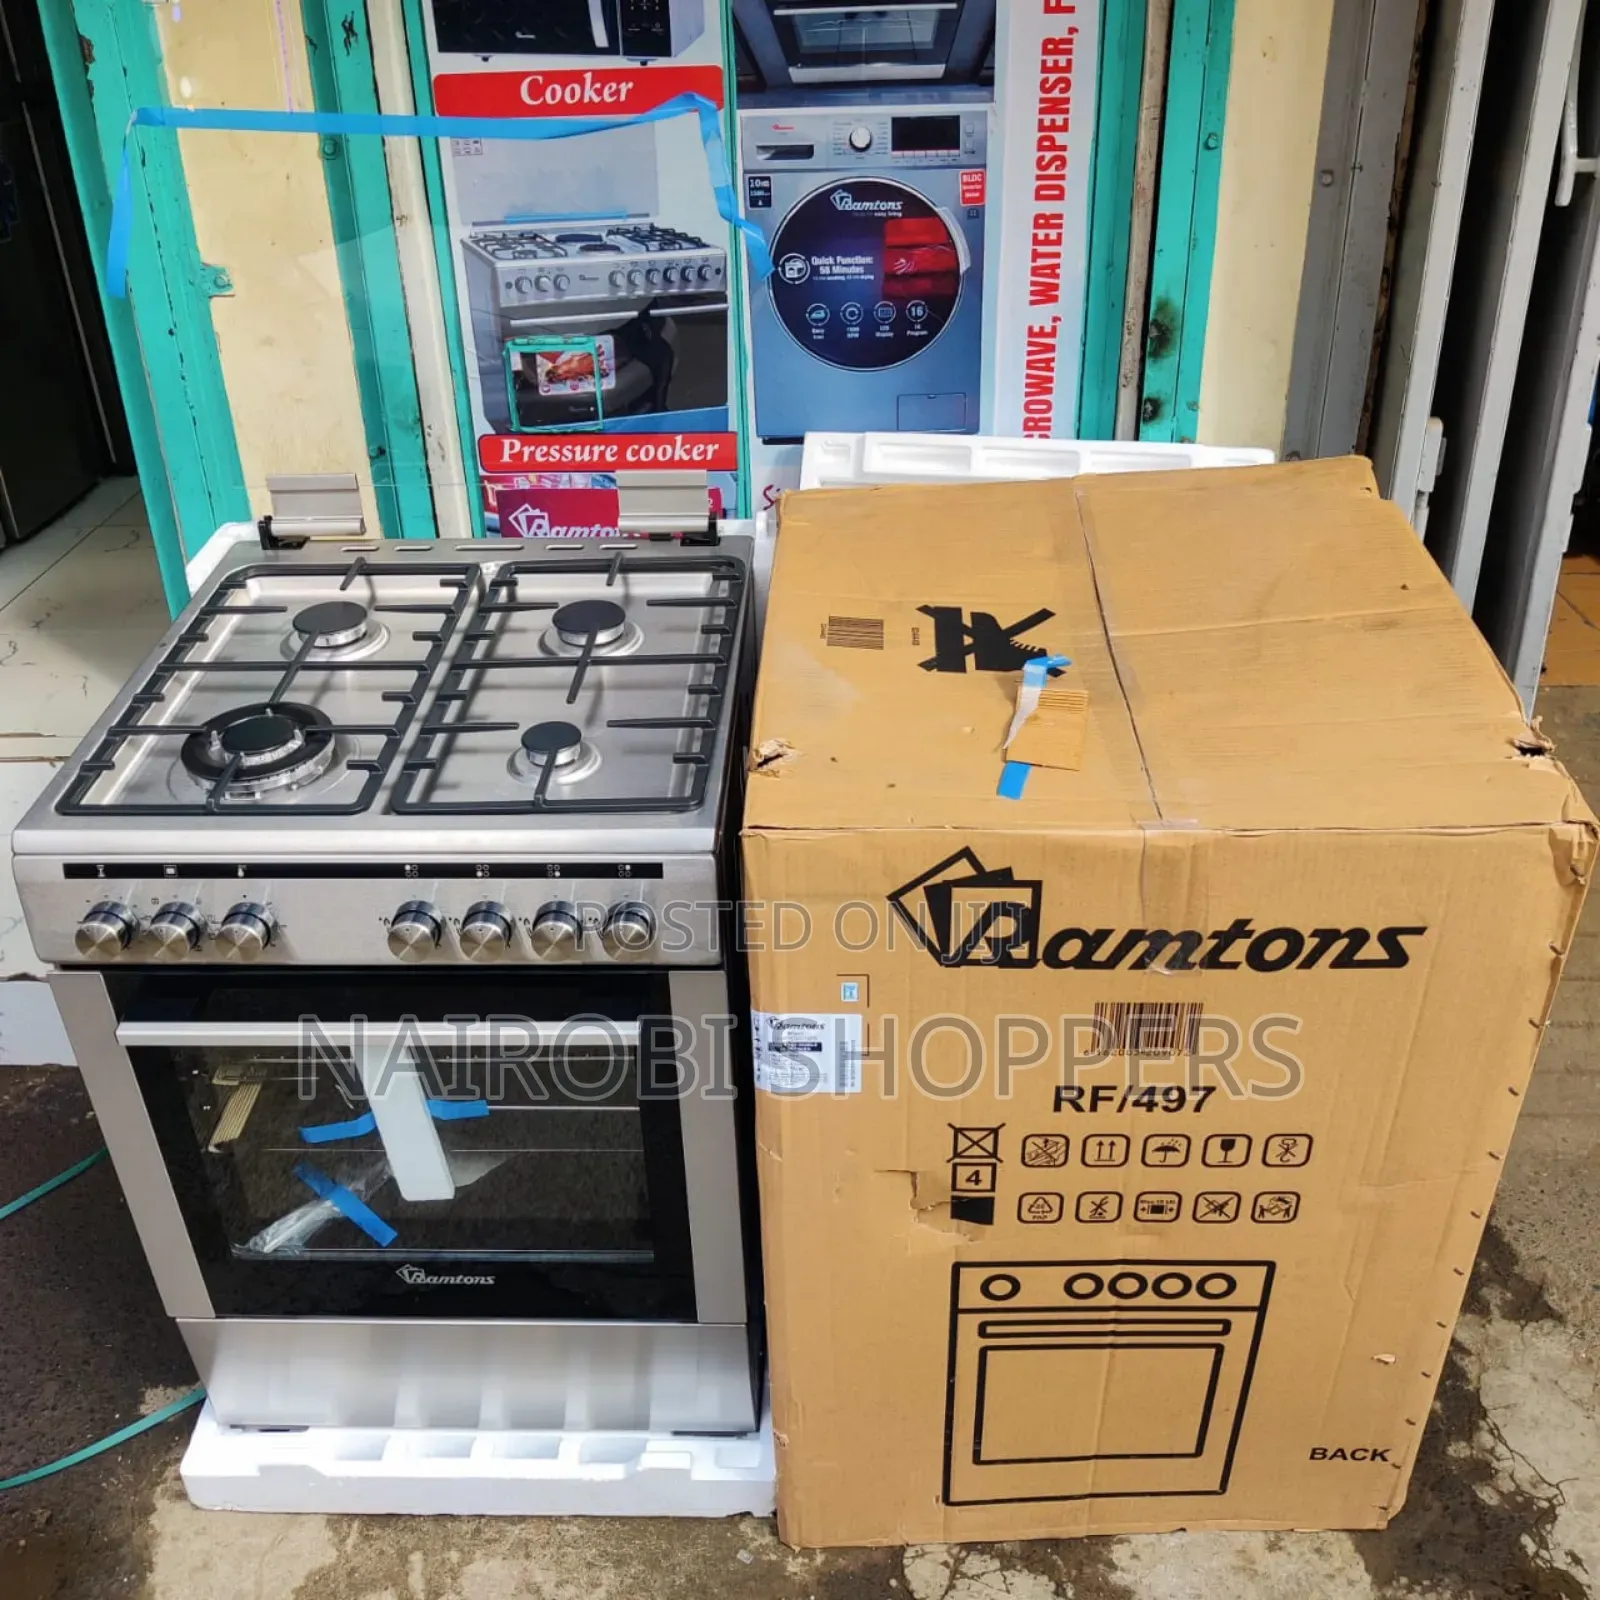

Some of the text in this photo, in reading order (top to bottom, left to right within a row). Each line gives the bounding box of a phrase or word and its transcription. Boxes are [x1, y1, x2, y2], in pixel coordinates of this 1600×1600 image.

[520, 72, 634, 106] Cooker
[1034, 26, 1080, 201] DISPENSER,
[835, 193, 903, 211] Ramtons
[811, 255, 874, 265] Quick Function:
[832, 265, 865, 274] Minutes
[1029, 212, 1065, 306] WATER
[911, 305, 923, 317] 16
[1023, 315, 1063, 439] ROWAVE,
[501, 435, 720, 463] Pressure cooker
[922, 876, 1427, 973] Ramtons
[1053, 1085, 1217, 1114] RF/497
[965, 1169, 983, 1186] 4
[402, 1268, 497, 1285] Ramtons
[1309, 1447, 1391, 1462] BACK
